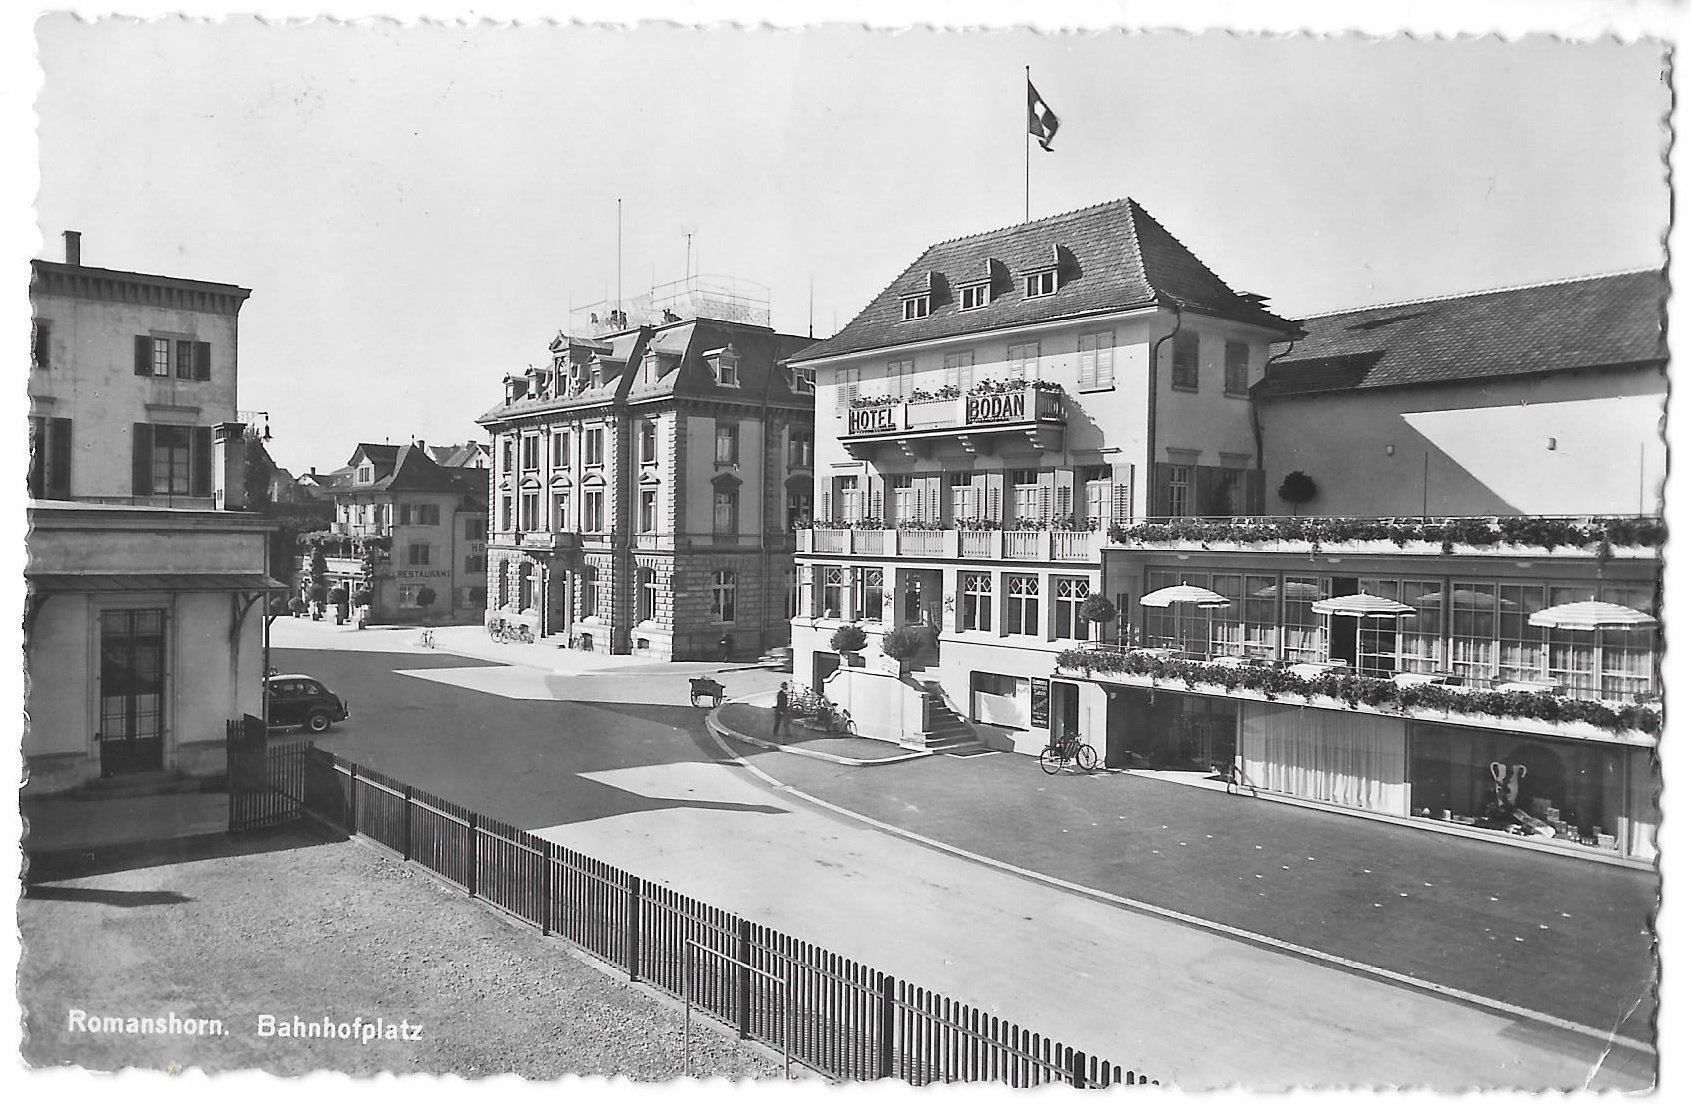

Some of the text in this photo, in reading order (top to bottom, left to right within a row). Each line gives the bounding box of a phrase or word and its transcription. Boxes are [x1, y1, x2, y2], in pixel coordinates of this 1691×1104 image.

[851, 394, 1025, 430] HOTEL BODAN
[397, 569, 451, 578] RESTAURANT
